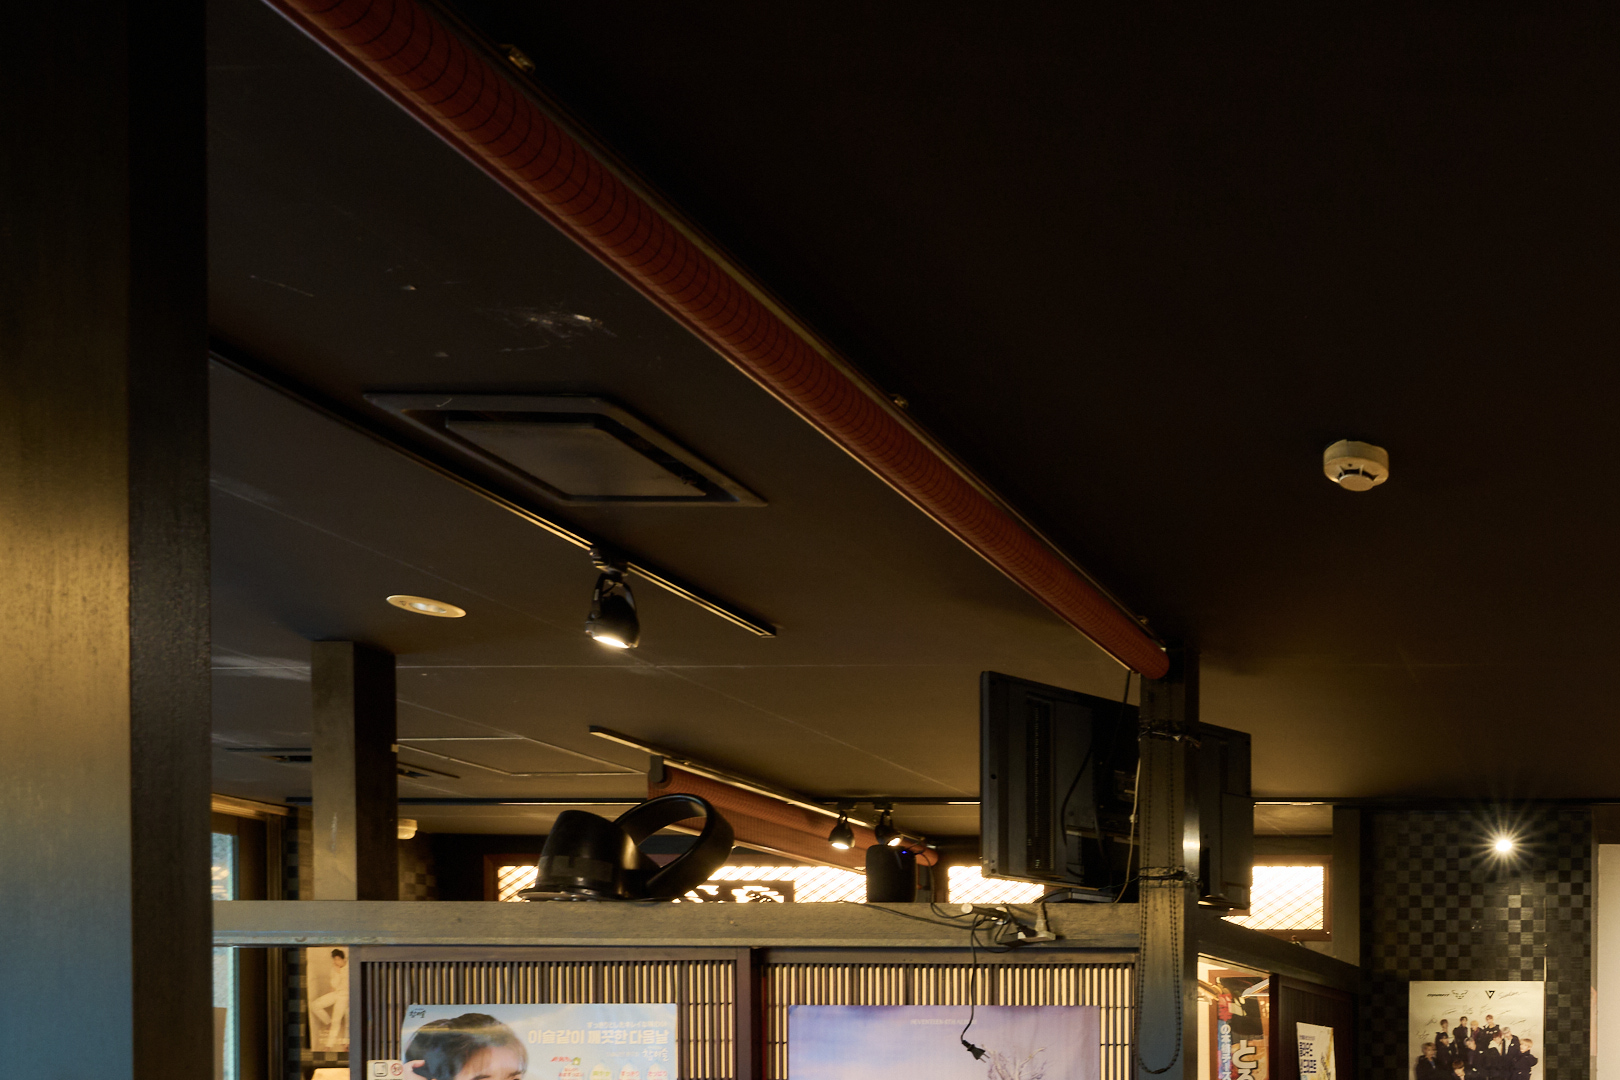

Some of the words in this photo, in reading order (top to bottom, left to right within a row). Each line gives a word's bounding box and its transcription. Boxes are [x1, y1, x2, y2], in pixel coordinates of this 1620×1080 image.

[528, 1029, 585, 1044] 이슬같이
[587, 1029, 628, 1044] 깨끗한
[629, 1029, 669, 1044] 다음날
